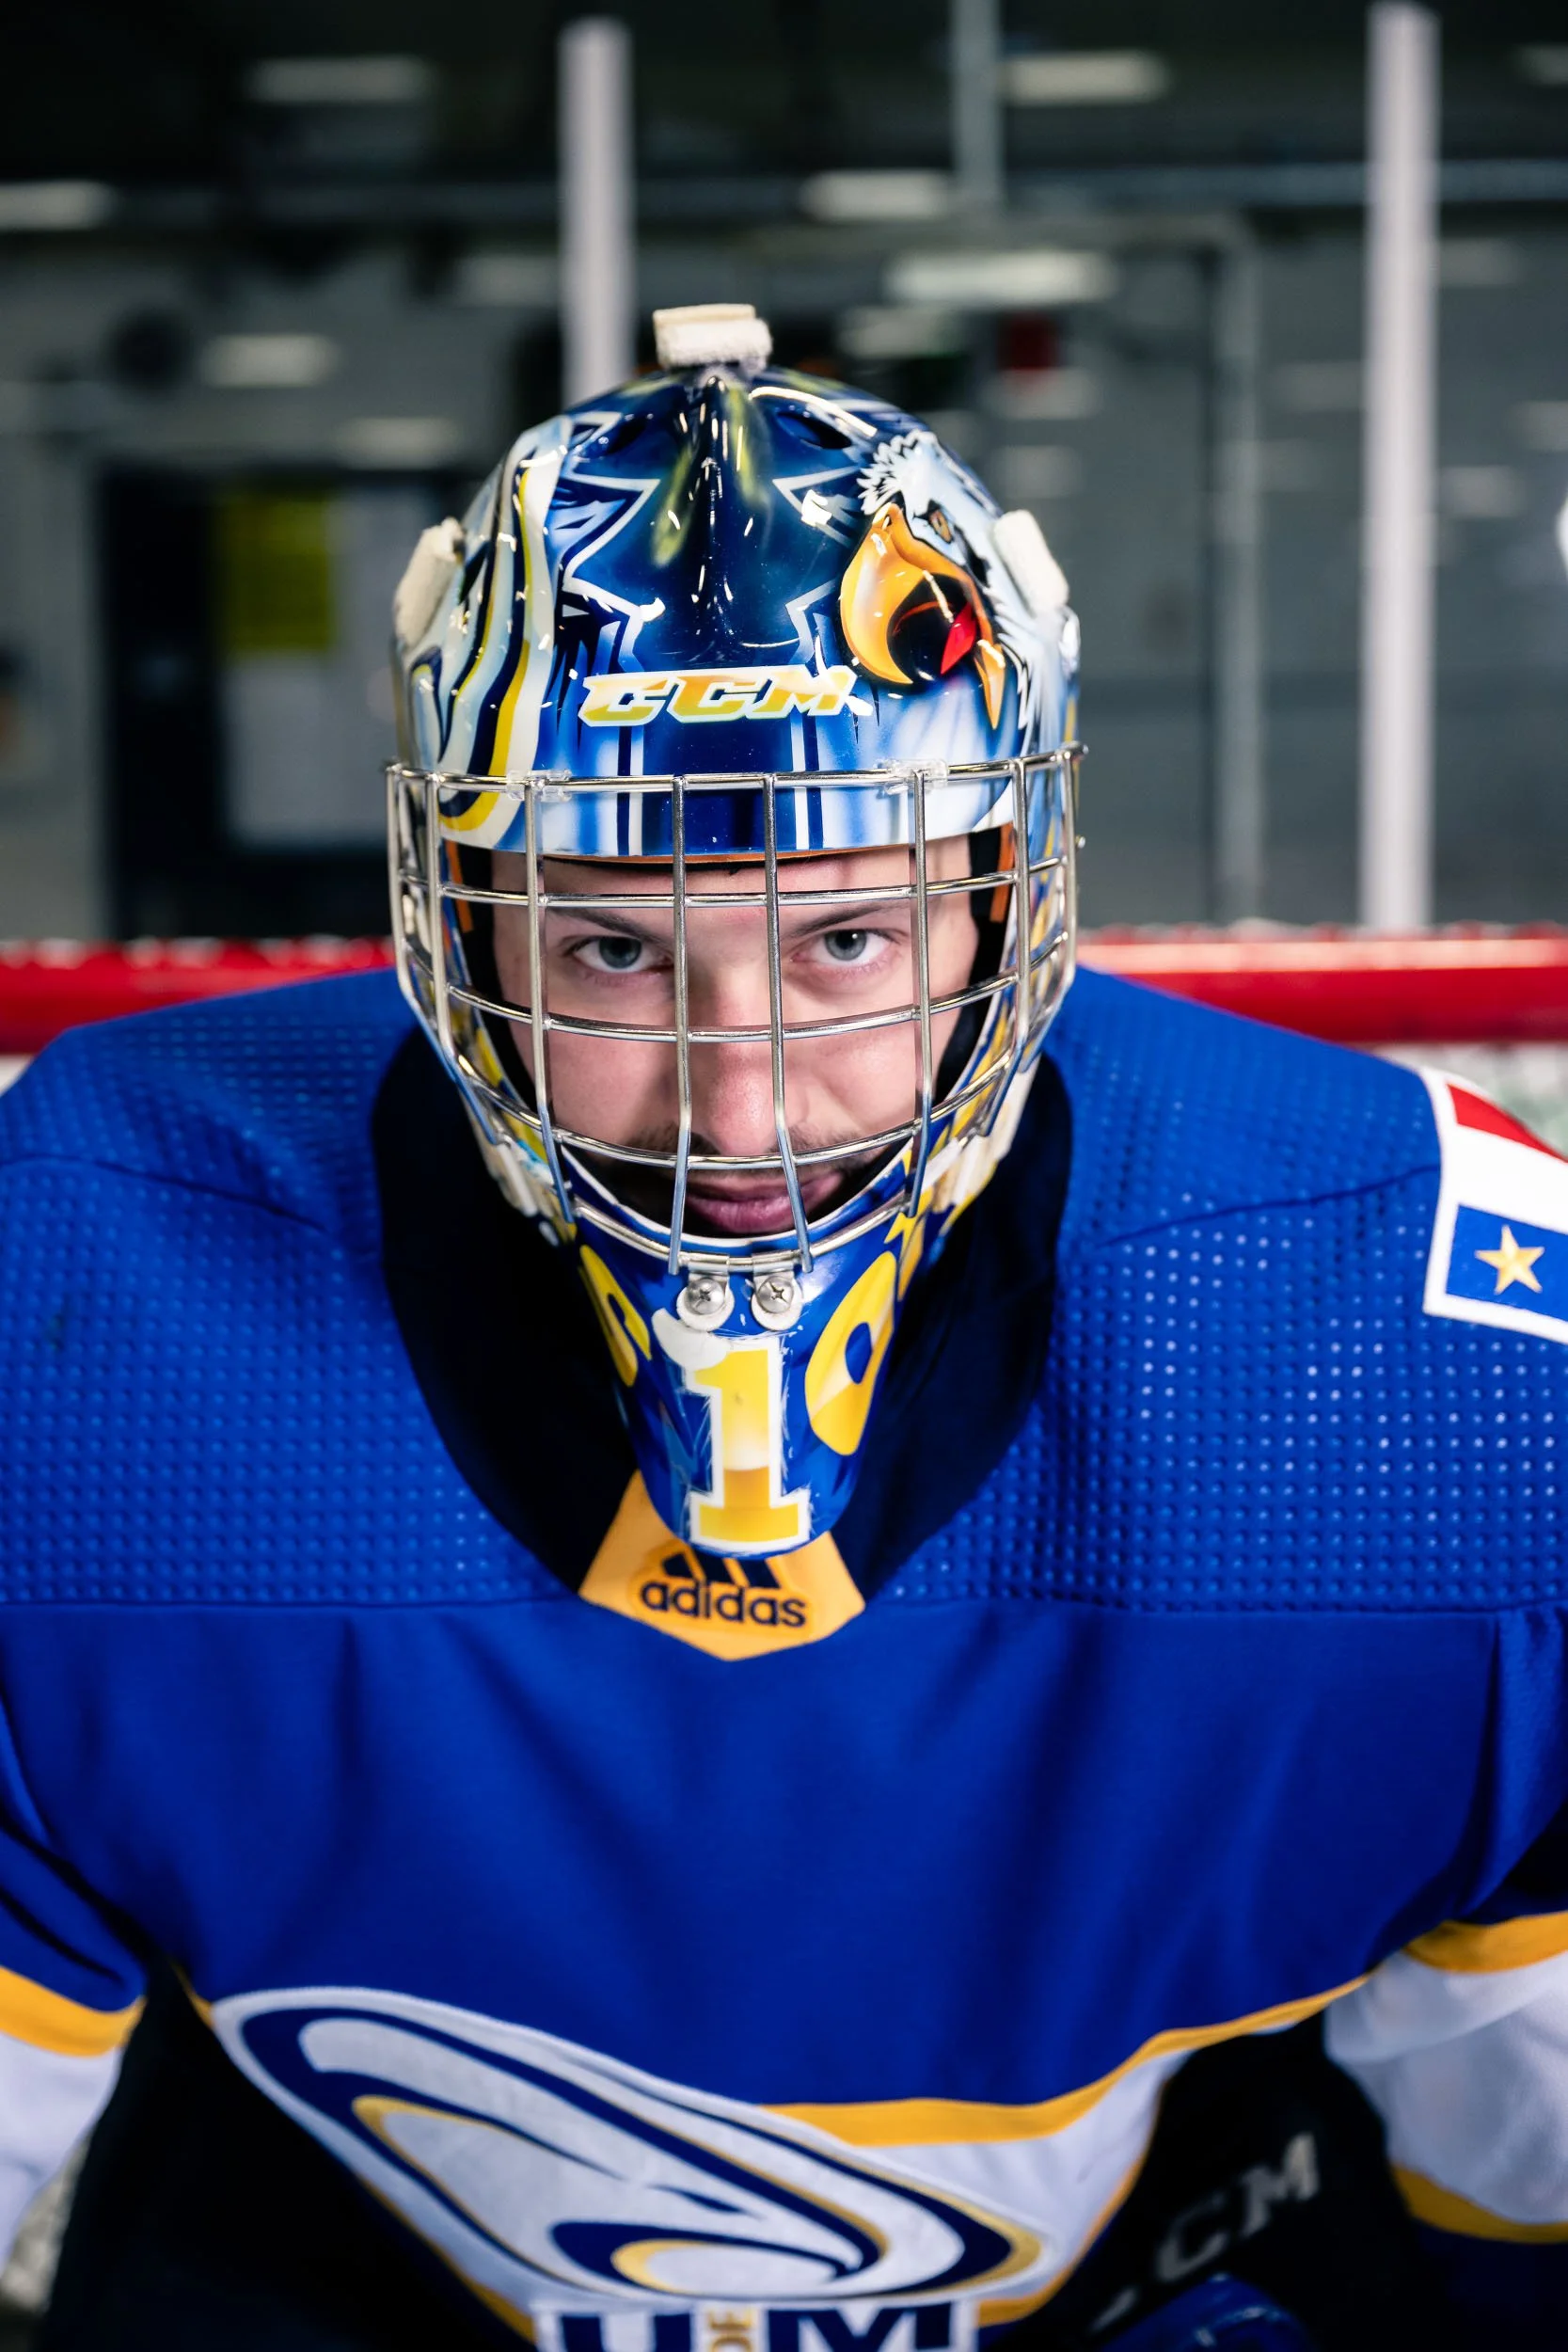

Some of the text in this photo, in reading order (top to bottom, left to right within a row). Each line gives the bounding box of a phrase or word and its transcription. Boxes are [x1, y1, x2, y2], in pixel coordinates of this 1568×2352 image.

[578, 664, 857, 727] CCM
[651, 1308, 811, 1554] 1
[640, 1578, 807, 1628] adidas
[1089, 2131, 1319, 2331] CM
